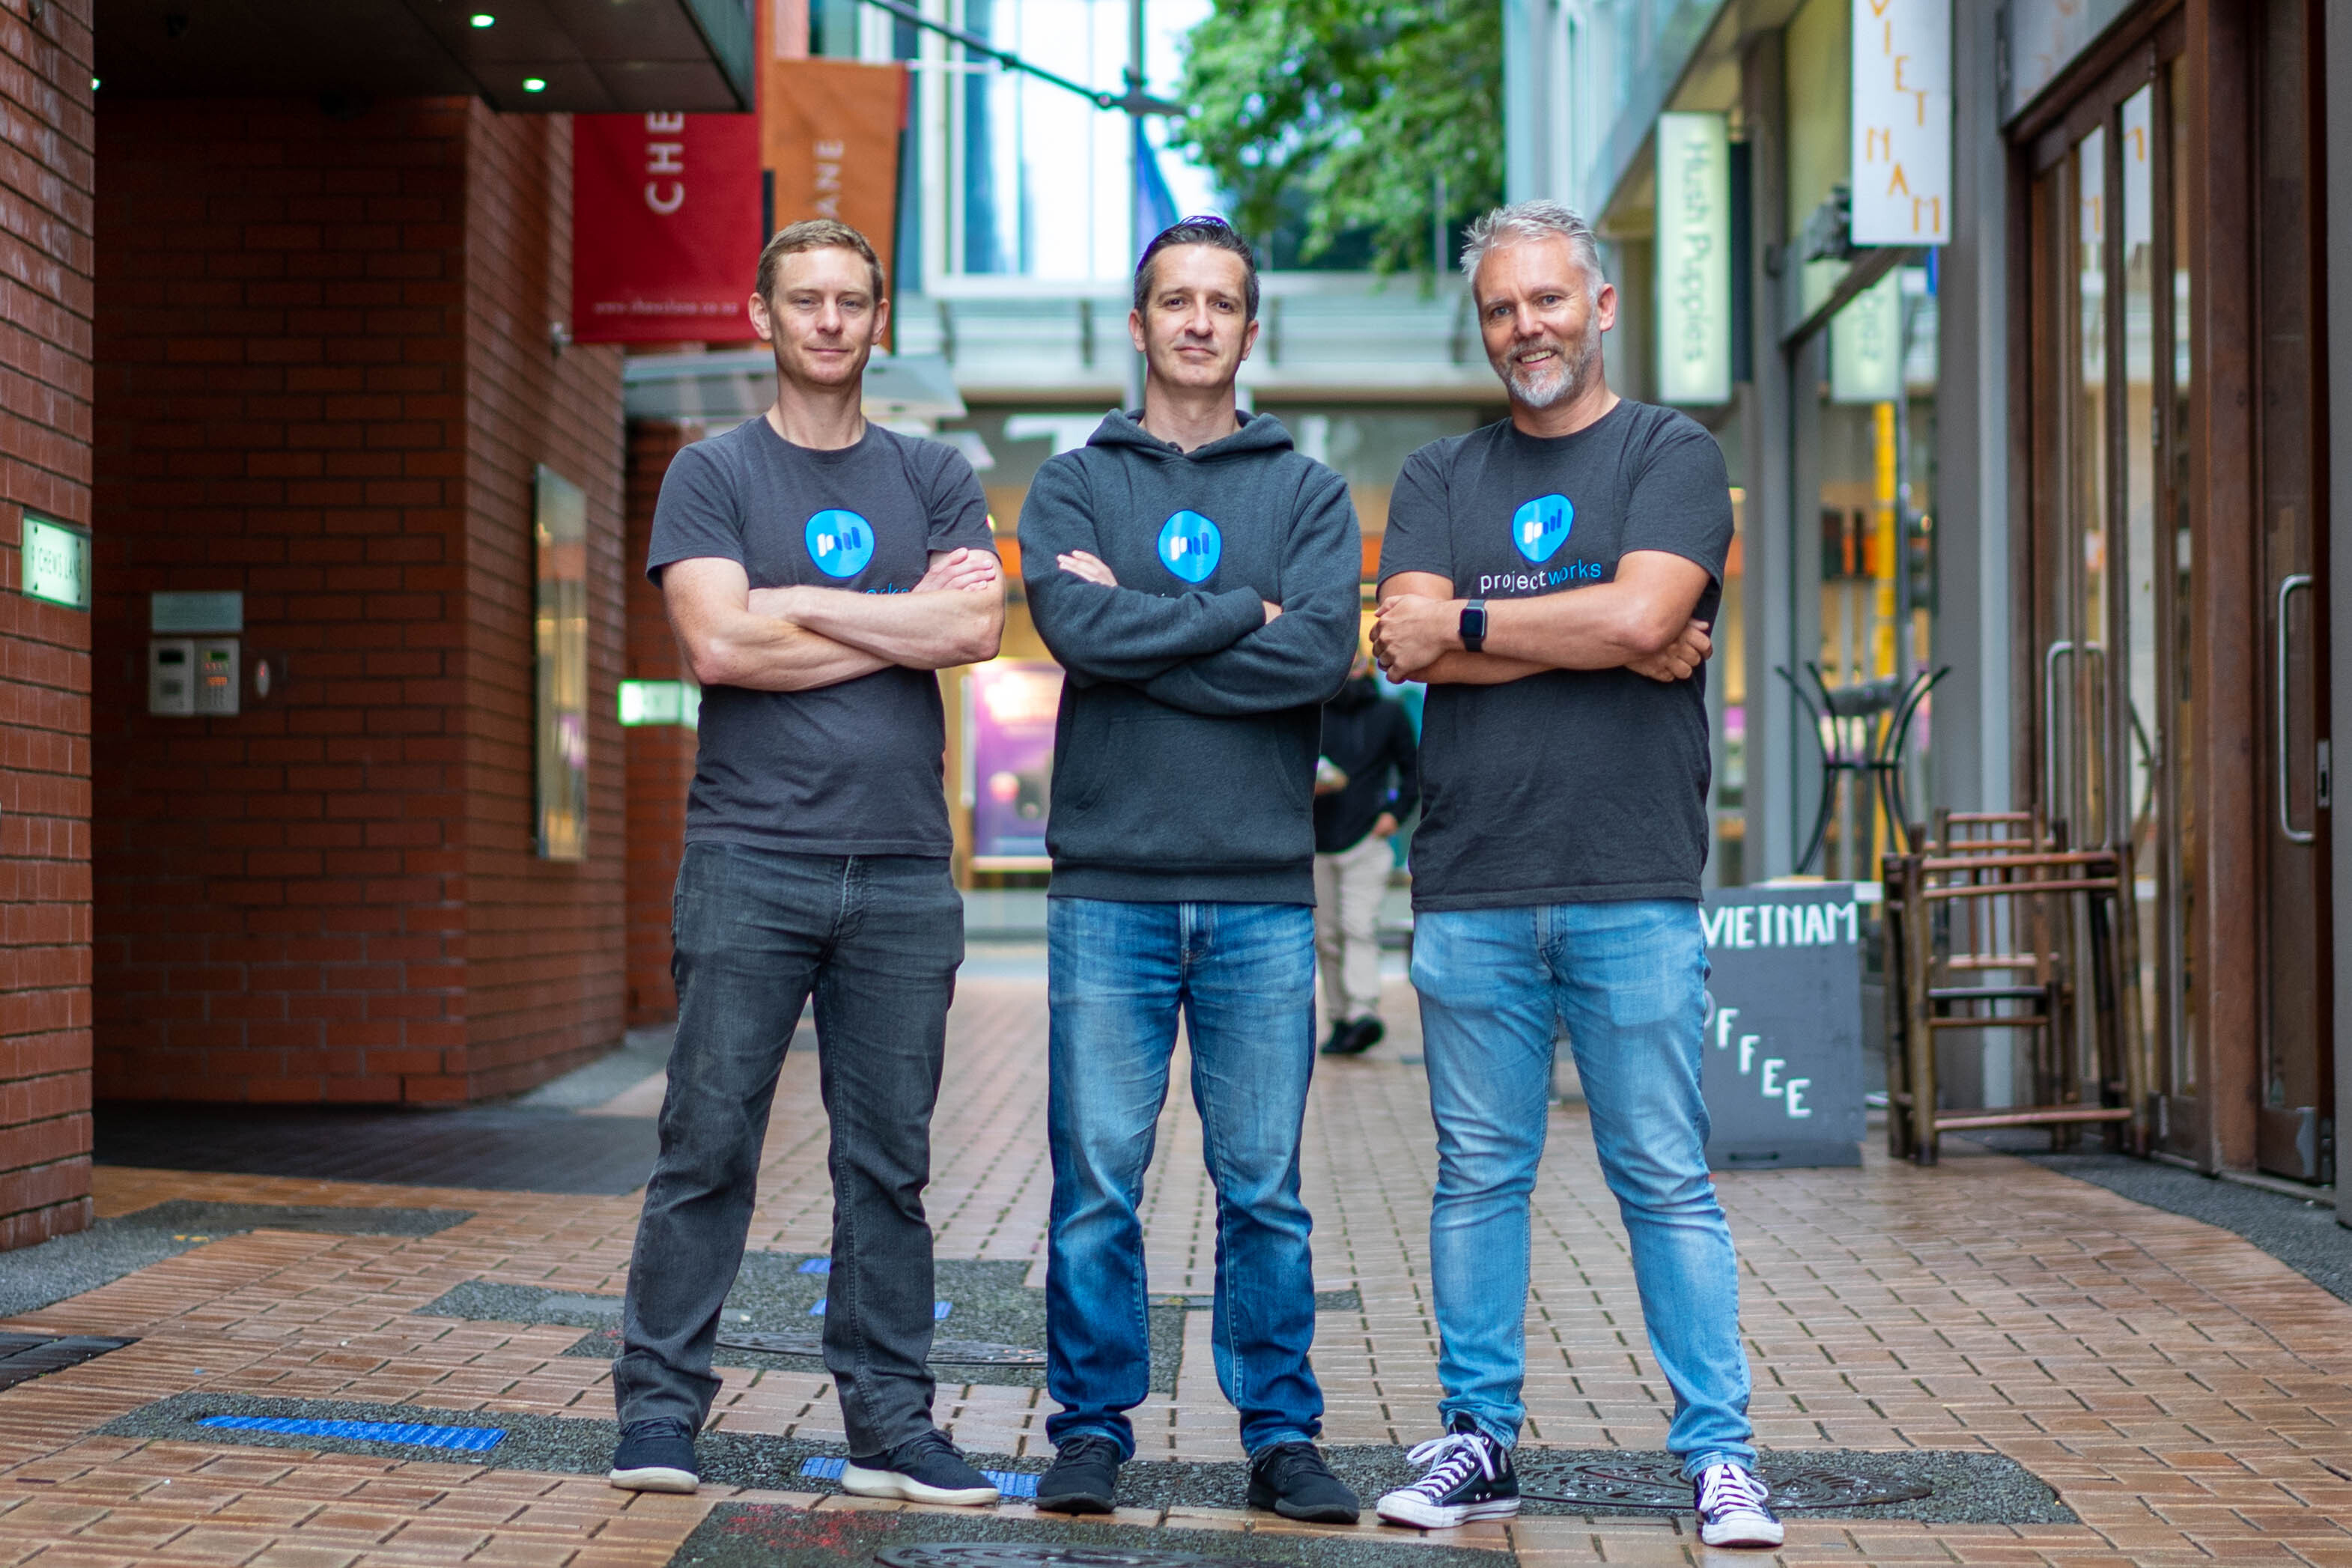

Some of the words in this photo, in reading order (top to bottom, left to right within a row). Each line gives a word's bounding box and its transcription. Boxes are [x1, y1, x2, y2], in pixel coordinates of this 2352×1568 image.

[645, 111, 684, 215] CHE
[1683, 142, 1710, 222] Hush
[1677, 233, 1712, 362] Puppies
[1480, 559, 1602, 594] projectworks
[1698, 901, 1858, 948] VIETNAM
